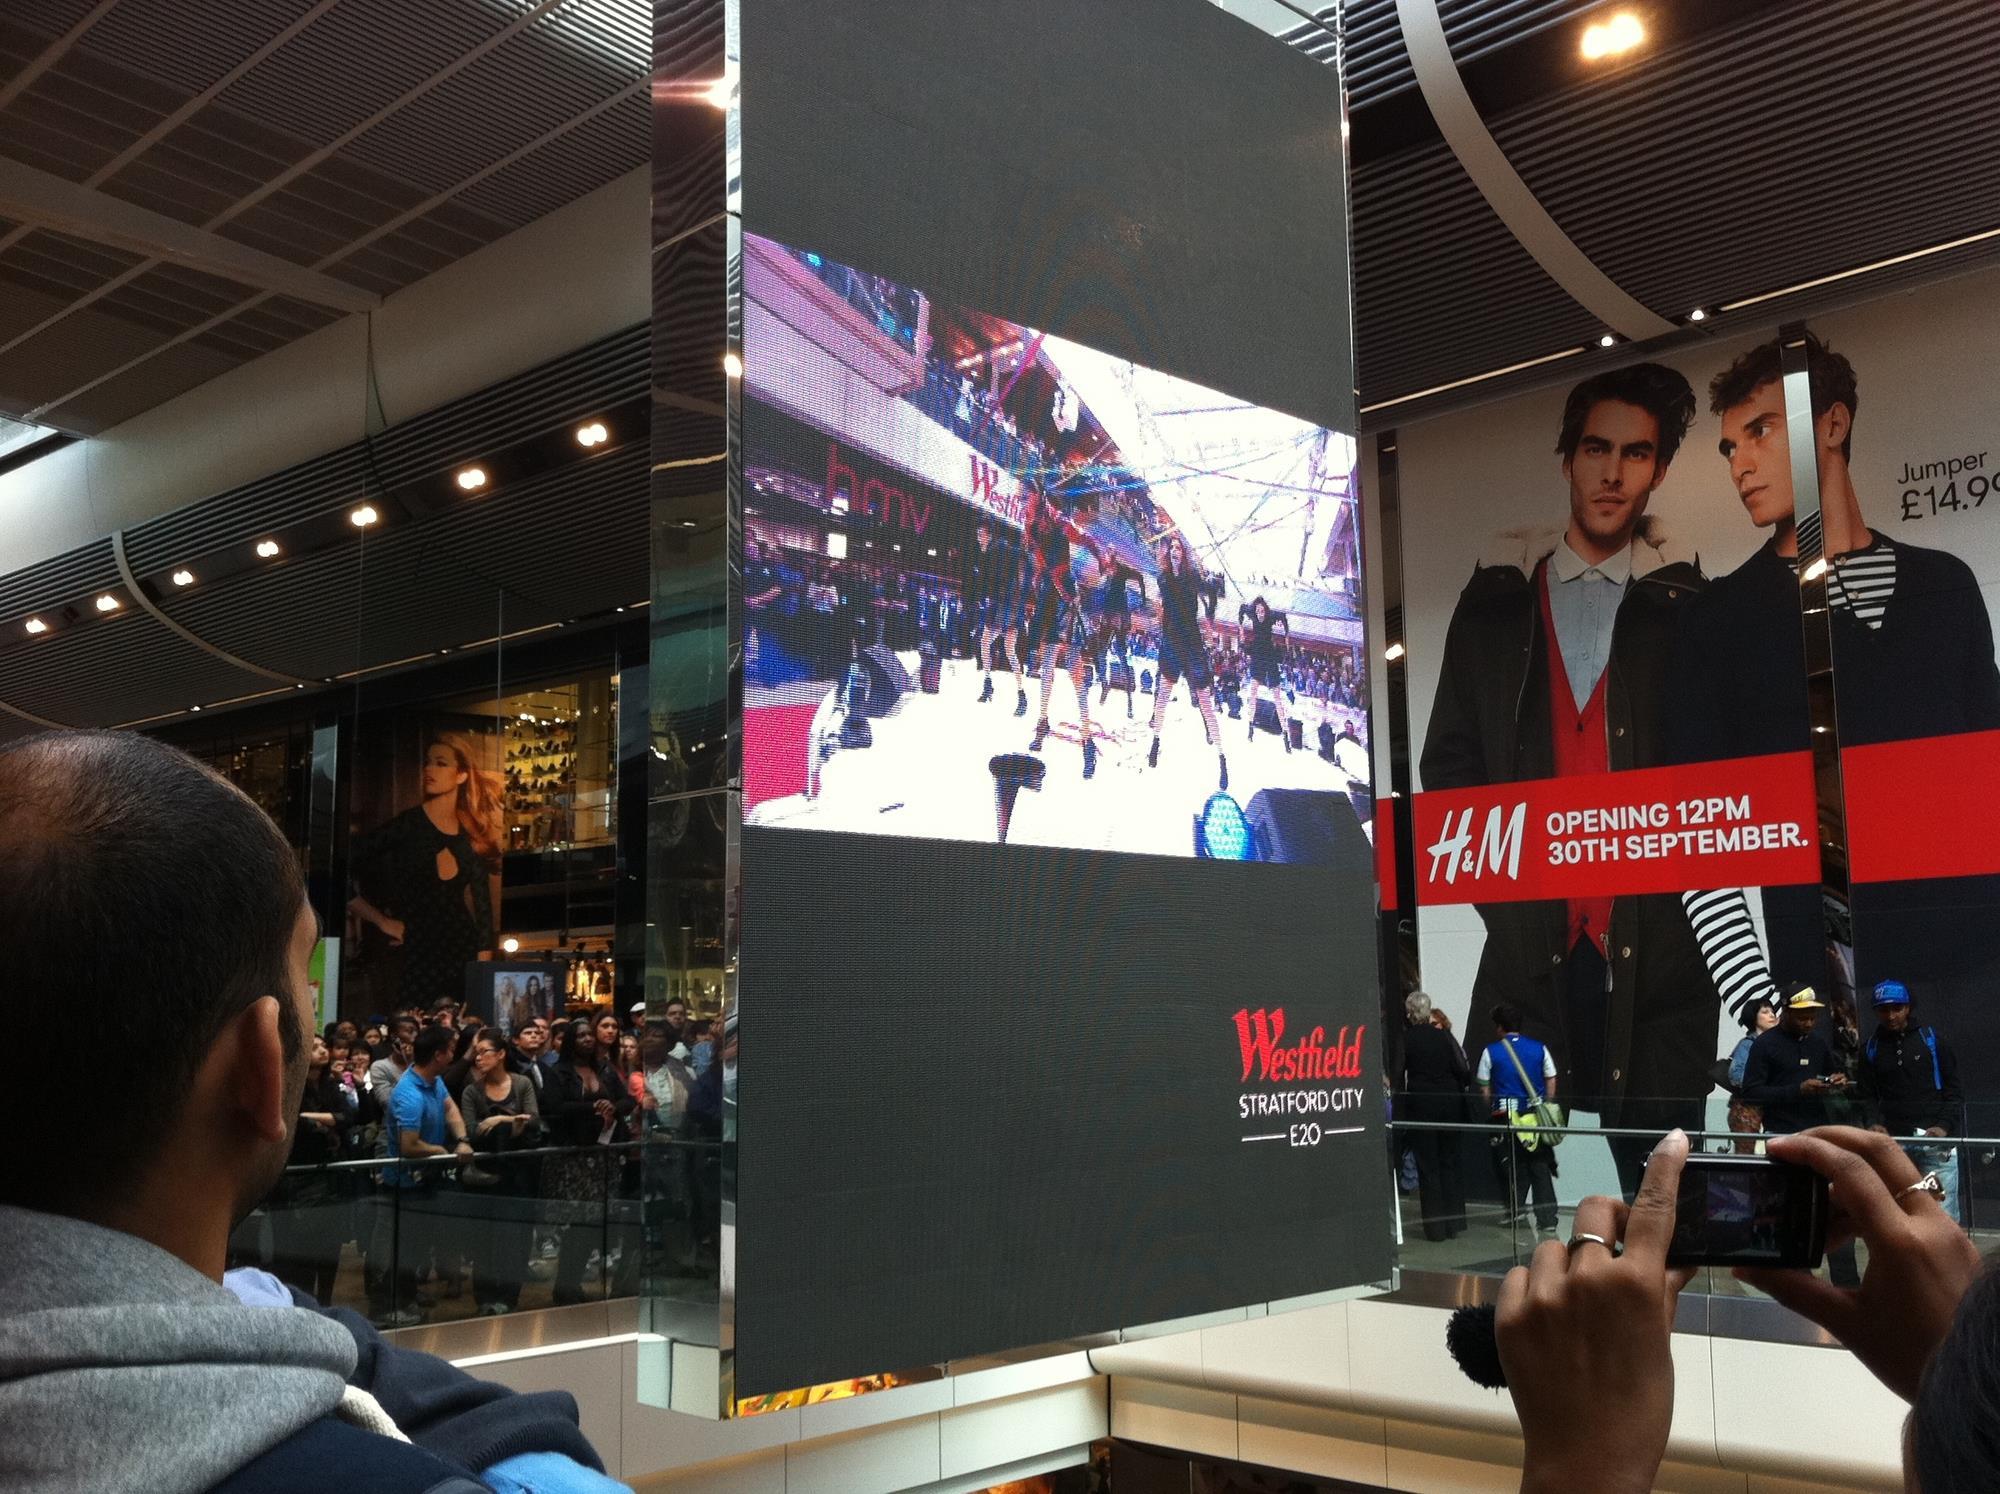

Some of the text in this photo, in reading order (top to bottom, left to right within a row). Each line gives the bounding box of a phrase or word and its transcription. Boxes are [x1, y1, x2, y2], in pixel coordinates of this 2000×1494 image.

[826, 442, 931, 535] hmv
[1897, 451, 1988, 485] Jumper
[1546, 794, 1751, 836] OPENING 12PM
[1427, 802, 1527, 884] H&M
[1548, 822, 1809, 866] 30TH SEPTEMBER.
[1232, 1008, 1366, 1082] Westfield
[1238, 1088, 1364, 1118] STRATFORD CITY
[1290, 1122, 1321, 1146] E20
